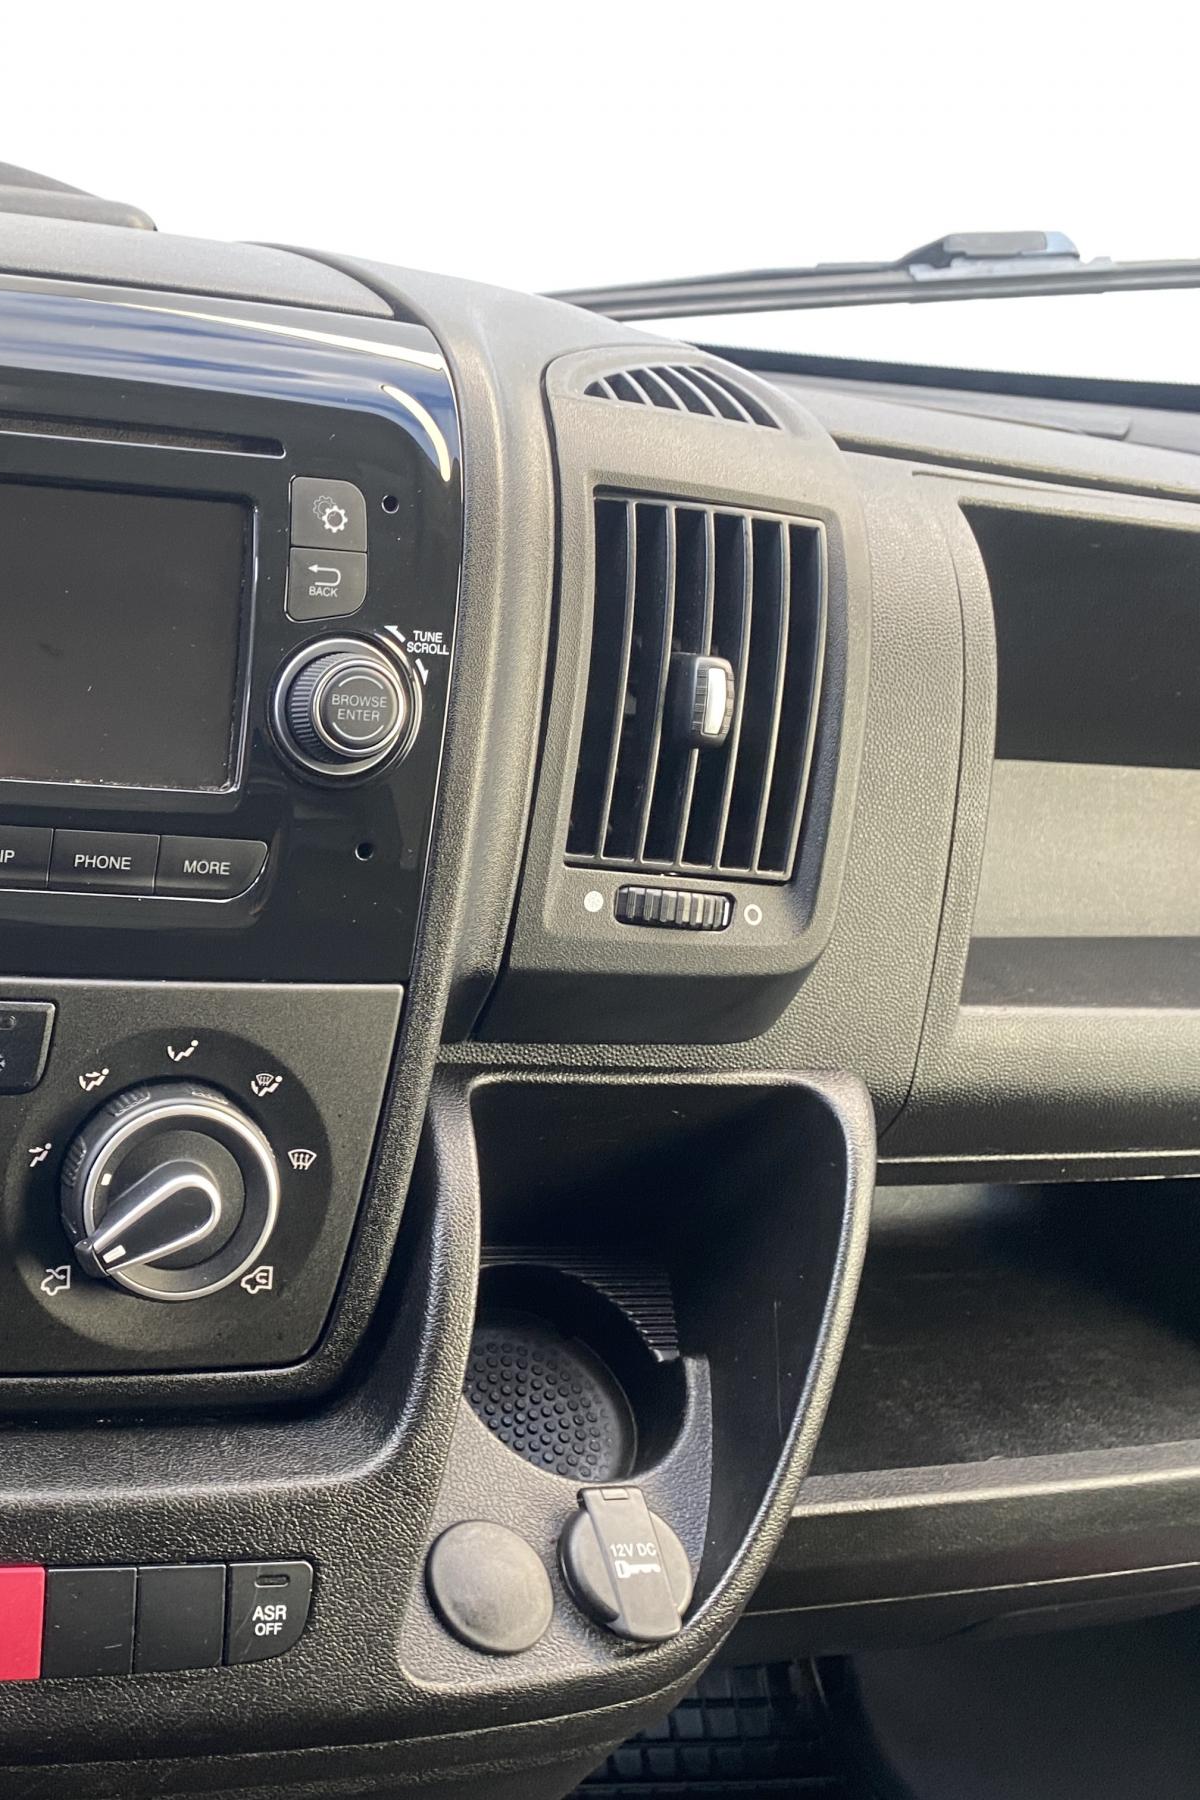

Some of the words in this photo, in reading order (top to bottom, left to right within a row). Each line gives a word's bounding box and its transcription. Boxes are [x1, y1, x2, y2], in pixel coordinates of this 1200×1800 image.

[309, 586, 338, 598] BACK
[413, 630, 443, 643] TUNE
[406, 640, 450, 656] SCROLL
[331, 693, 388, 709] BROWSE
[337, 709, 381, 723] ENTER
[73, 853, 132, 871] PHONE
[183, 859, 232, 876] MORE
[610, 1543, 633, 1558] 12V
[637, 1542, 657, 1556] DC
[252, 1604, 288, 1622] ASR
[254, 1622, 283, 1636] OFF
